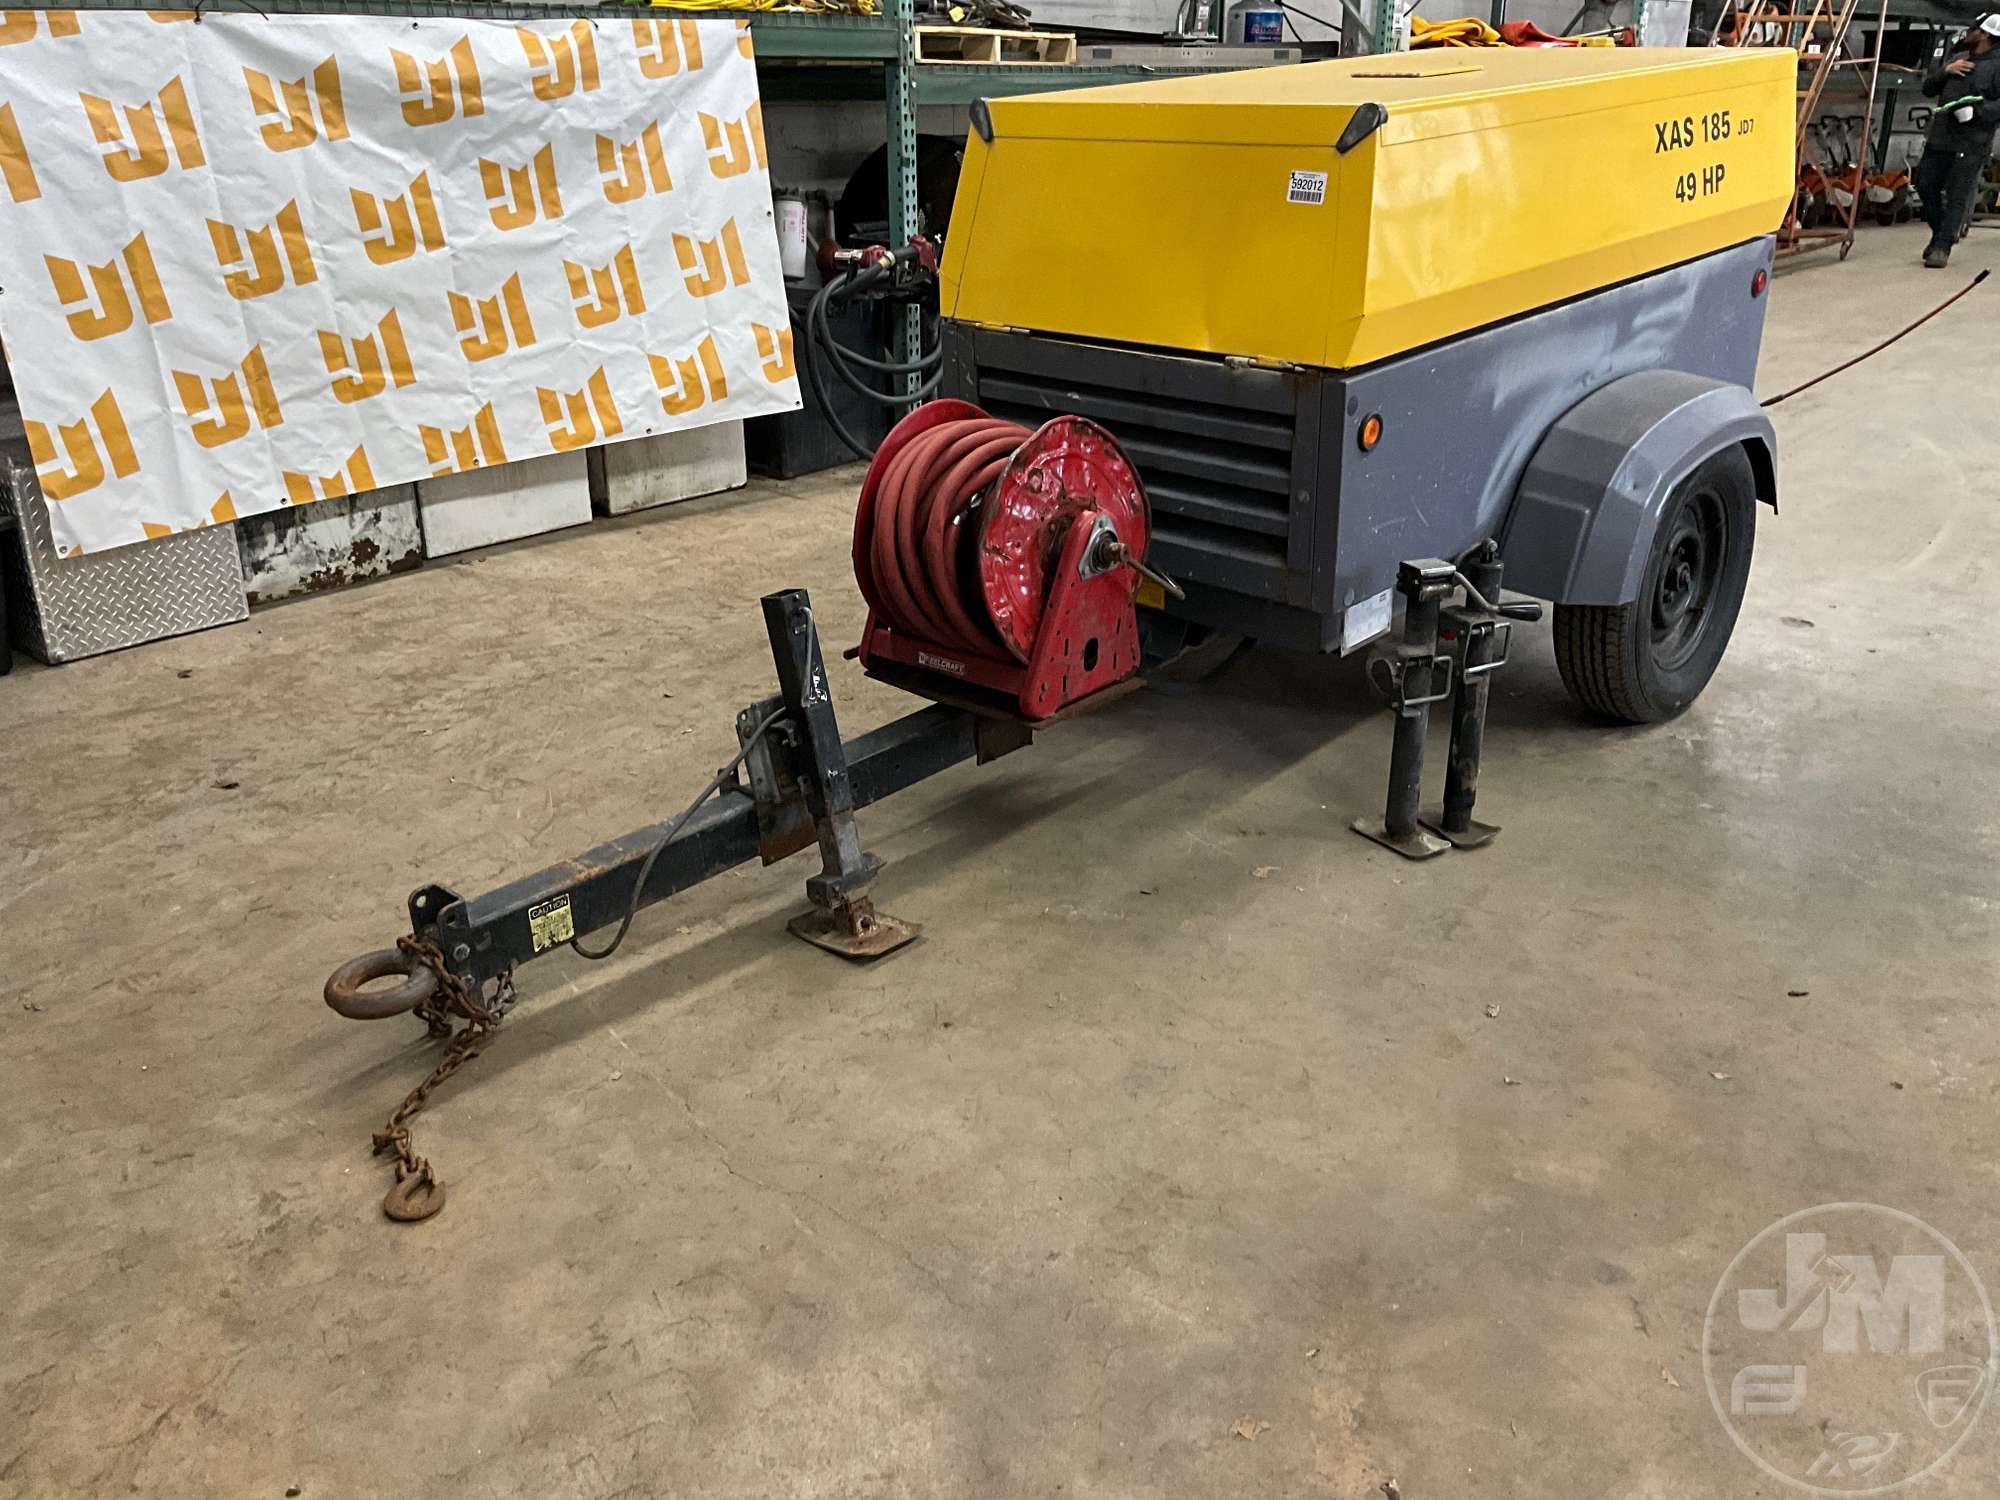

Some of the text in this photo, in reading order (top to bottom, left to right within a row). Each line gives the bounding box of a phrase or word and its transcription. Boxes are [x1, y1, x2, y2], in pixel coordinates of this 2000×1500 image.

[1655, 110, 1755, 154] XAS 185 JD7
[1291, 178, 1324, 191] 592012
[1675, 163, 1725, 203] 49 HP
[531, 898, 568, 918] CAUTION
